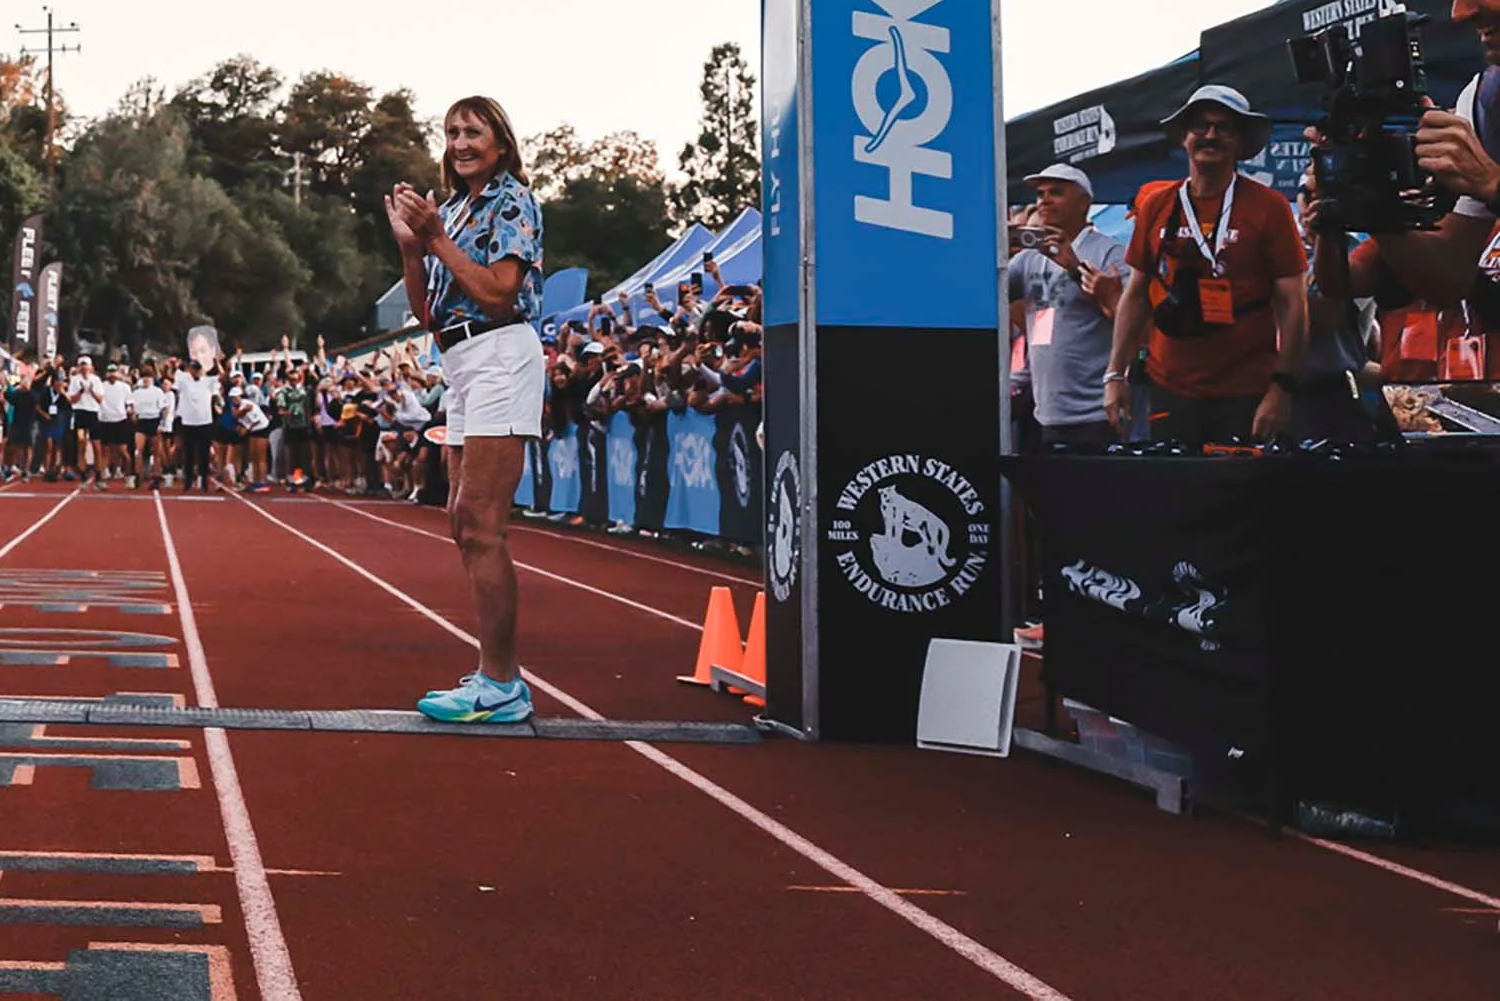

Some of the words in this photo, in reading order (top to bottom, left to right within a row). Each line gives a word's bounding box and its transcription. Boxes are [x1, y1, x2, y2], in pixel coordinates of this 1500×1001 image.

[836, 454, 920, 512] WESTERN
[922, 458, 985, 516] STATES
[832, 520, 852, 530] 100
[968, 523, 991, 533] ONE
[828, 530, 860, 540] MILES
[968, 534, 989, 544] DAY
[836, 551, 951, 613] ENDURANCE
